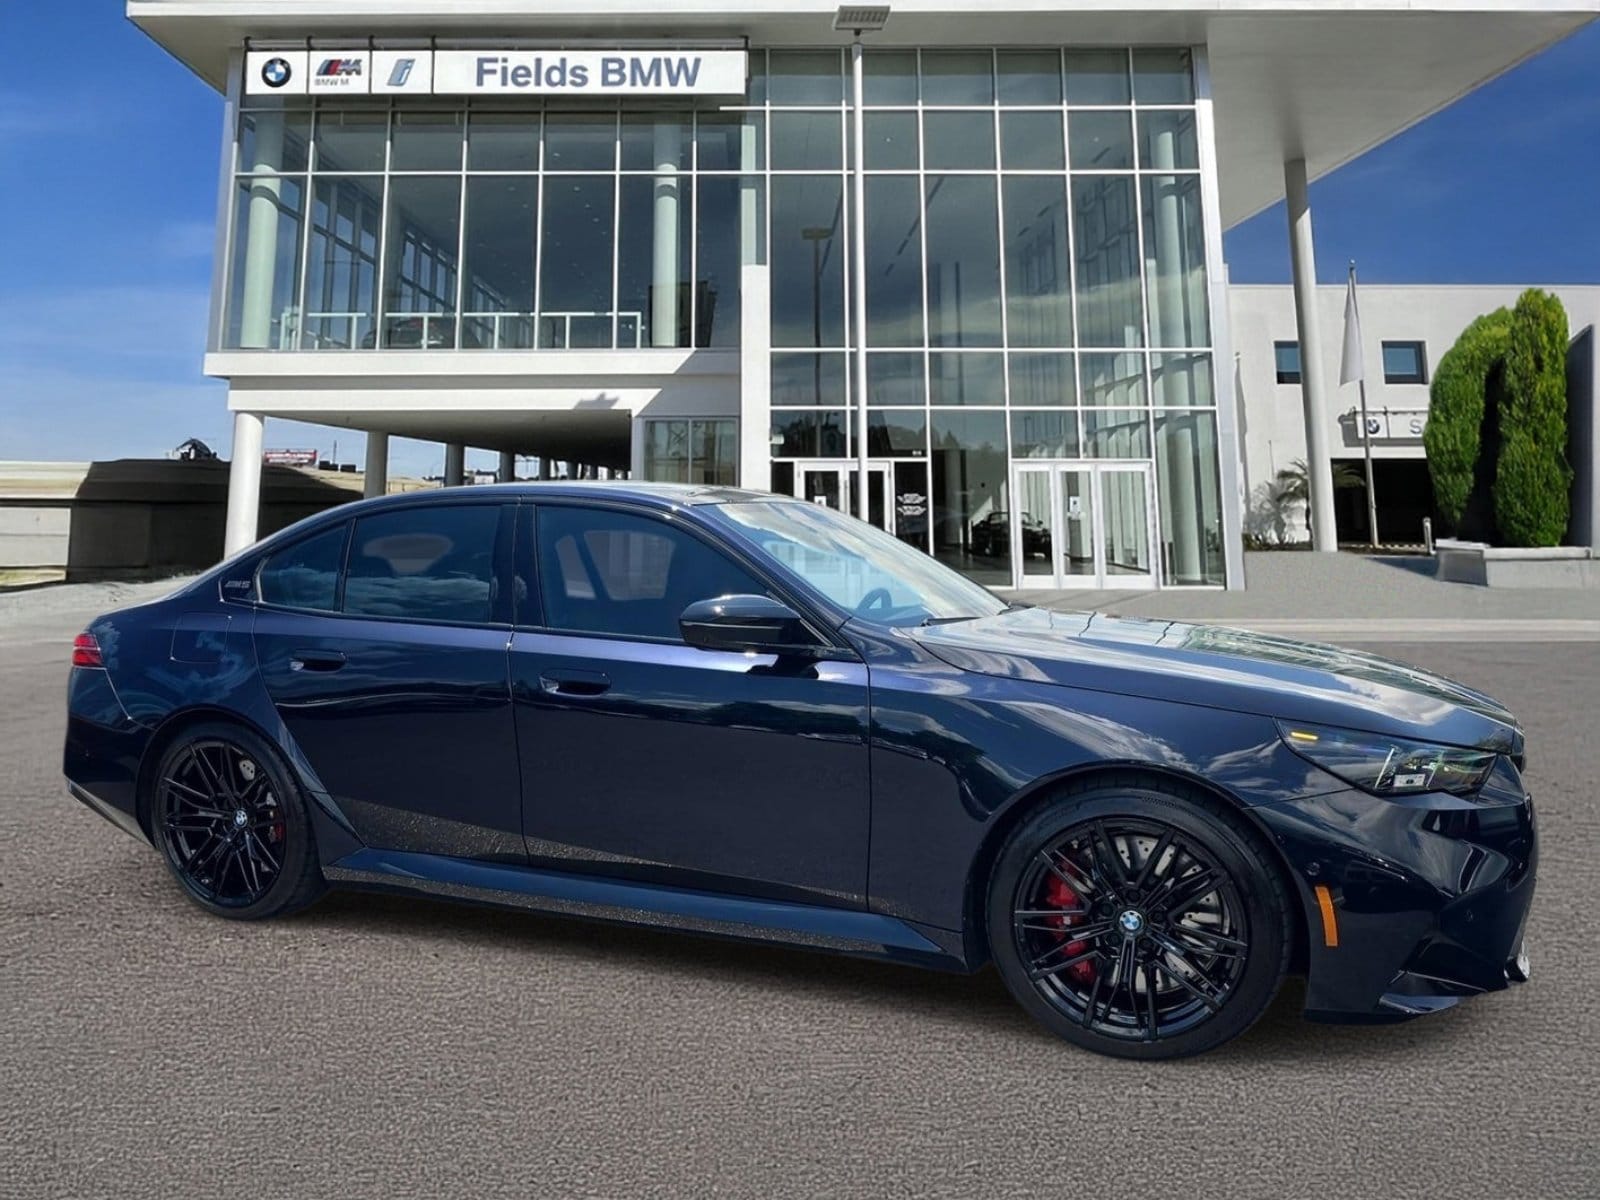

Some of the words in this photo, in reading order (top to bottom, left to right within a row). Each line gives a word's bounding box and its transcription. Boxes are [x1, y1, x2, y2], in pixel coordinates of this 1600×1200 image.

[476, 57, 589, 87] Fields
[601, 57, 702, 87] BMW
[1409, 419, 1423, 435] S
